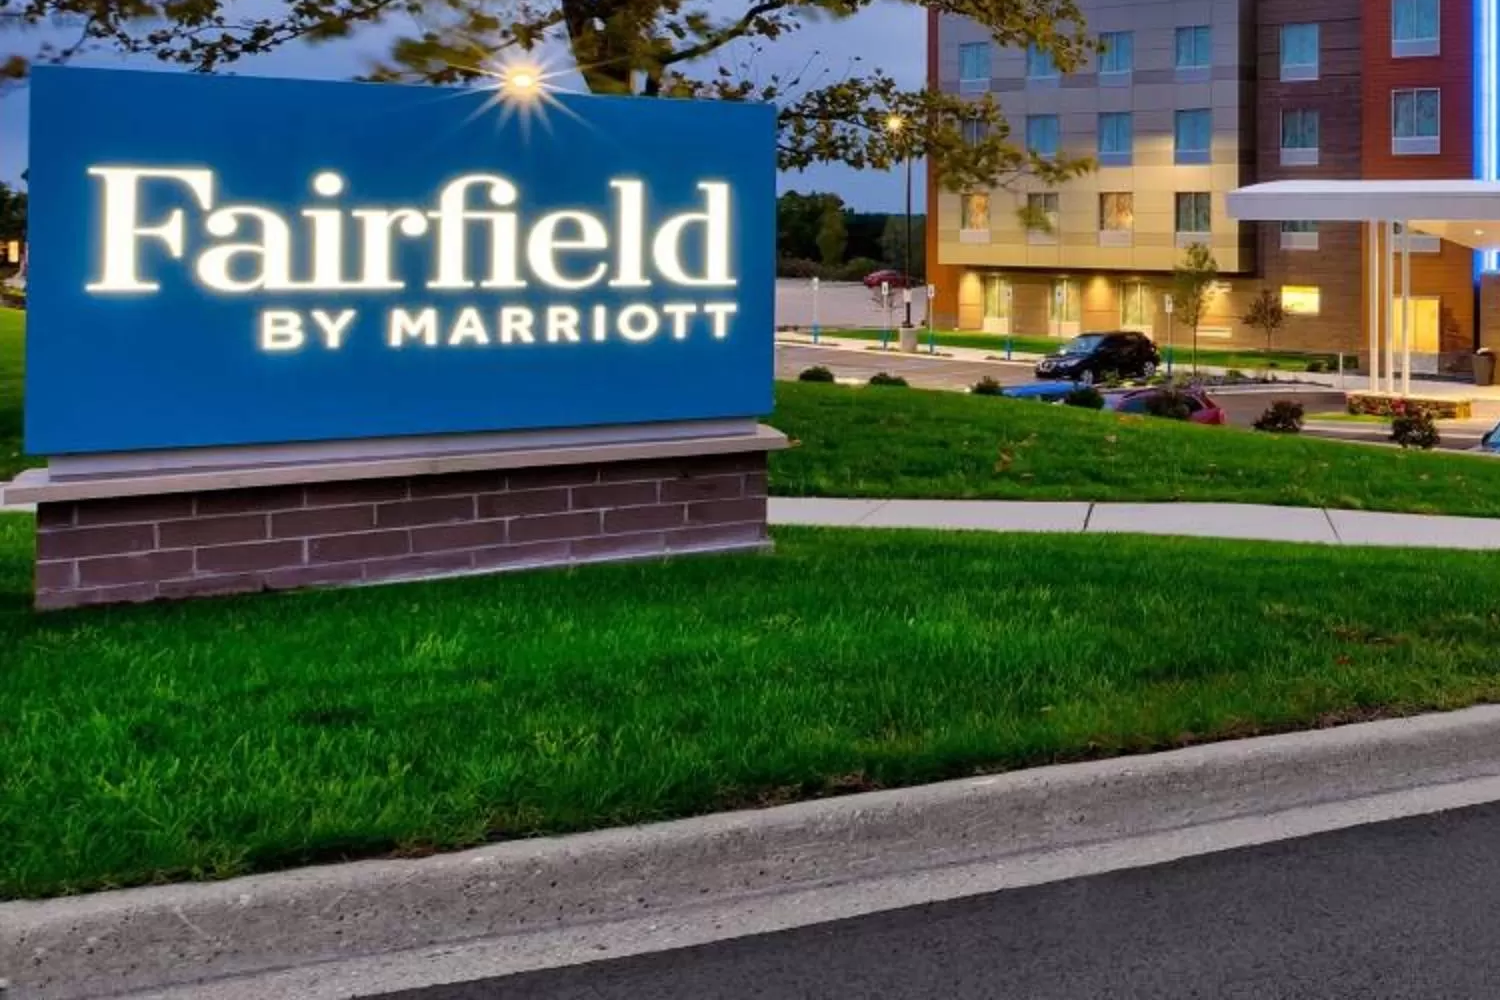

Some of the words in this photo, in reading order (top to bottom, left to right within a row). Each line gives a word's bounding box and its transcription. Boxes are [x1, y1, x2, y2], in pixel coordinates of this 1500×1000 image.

[84, 164, 739, 294] Fairfield
[259, 308, 358, 351] BY
[387, 302, 739, 348] MARRIOTT
